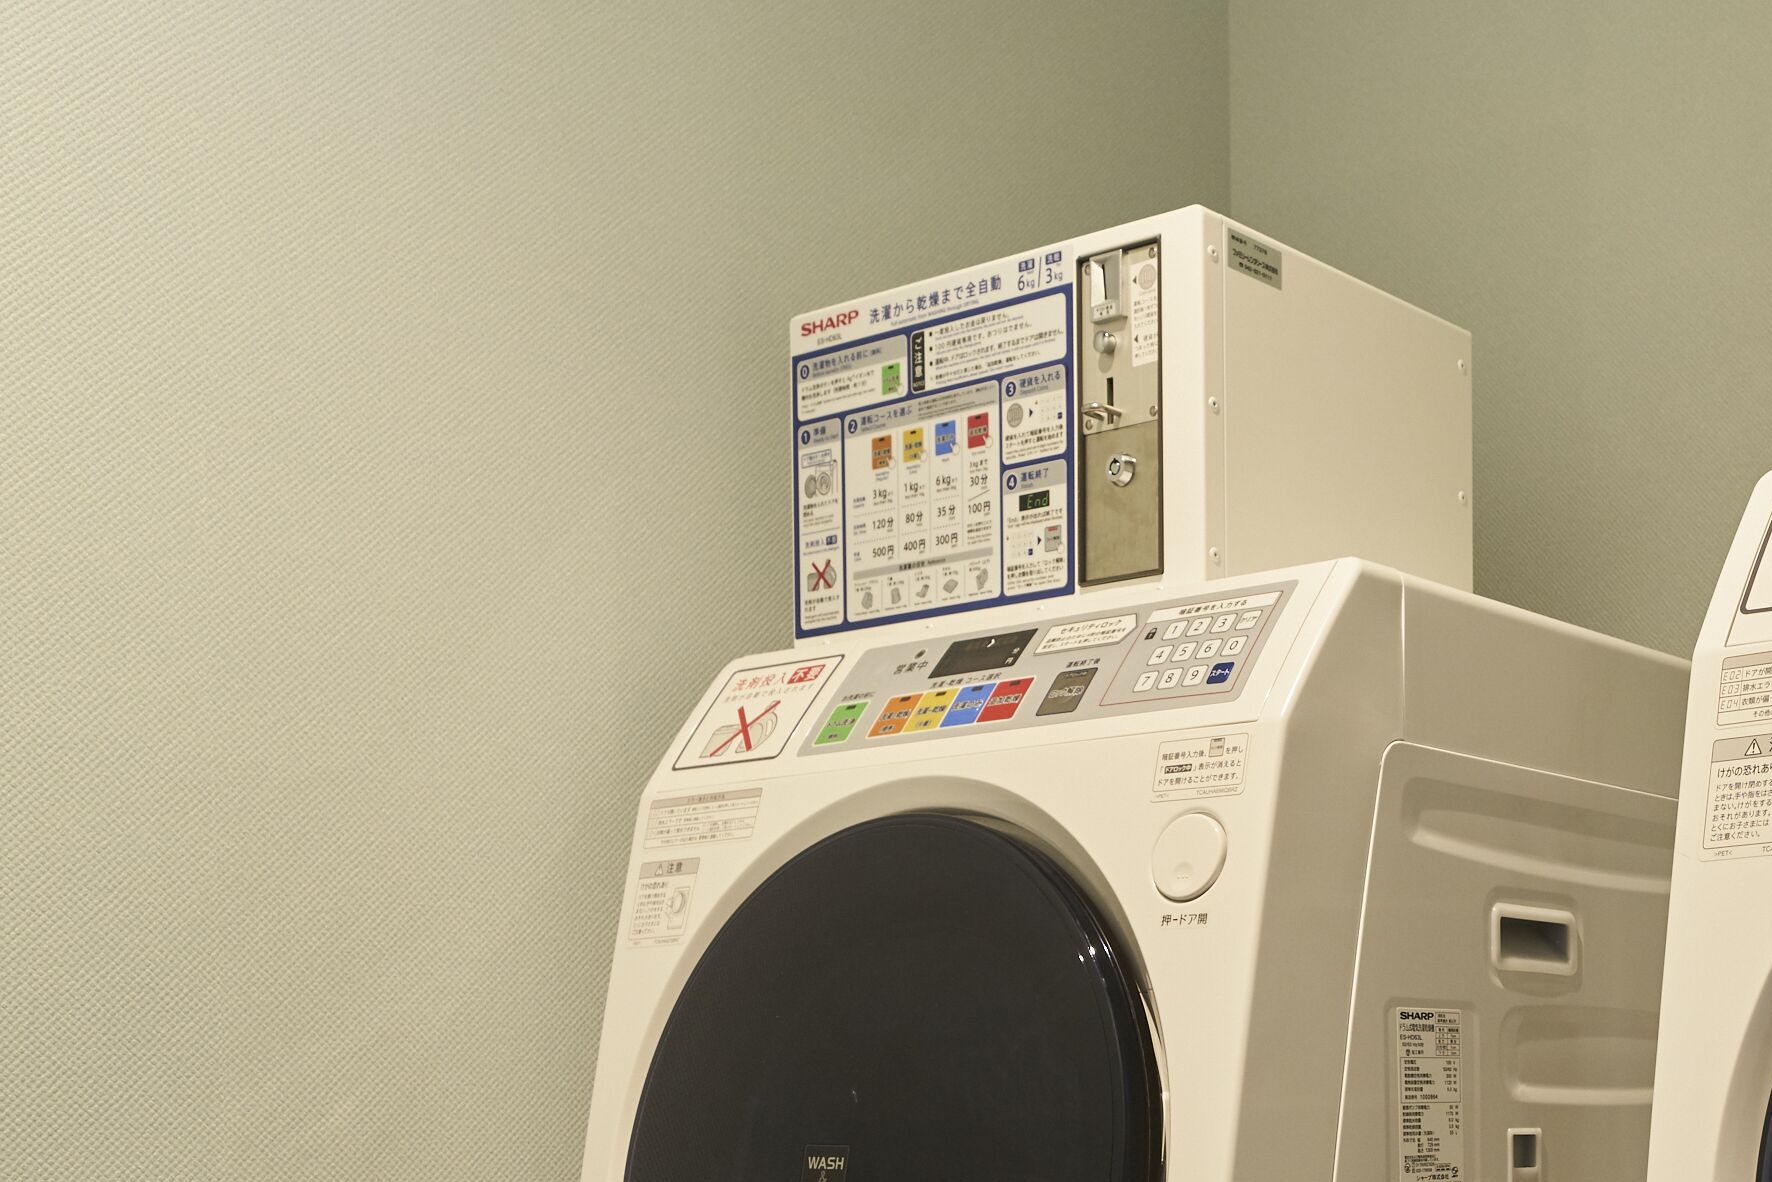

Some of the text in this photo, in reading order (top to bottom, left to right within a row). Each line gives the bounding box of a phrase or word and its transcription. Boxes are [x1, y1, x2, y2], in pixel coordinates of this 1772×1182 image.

[868, 274, 1002, 325] 洗濯から乾燥まで全自動
[800, 309, 860, 337] SHARP
[1026, 494, 1049, 510] End
[1178, 599, 1248, 616] 暗証番号を入力する
[1060, 618, 1123, 636] セキュリティロック
[1171, 617, 1228, 636] 1 2 3
[1154, 640, 1239, 660] 4 5 6 0
[1142, 667, 1231, 687] 7 8 9 スタート
[1157, 771, 1240, 786] ドアを開けることができます。
[1711, 819, 1769, 832] とくにお子さまには
[1710, 831, 1761, 842] ご注意ください。
[1399, 1011, 1434, 1020] SHARP
[808, 1156, 845, 1170] WASH
